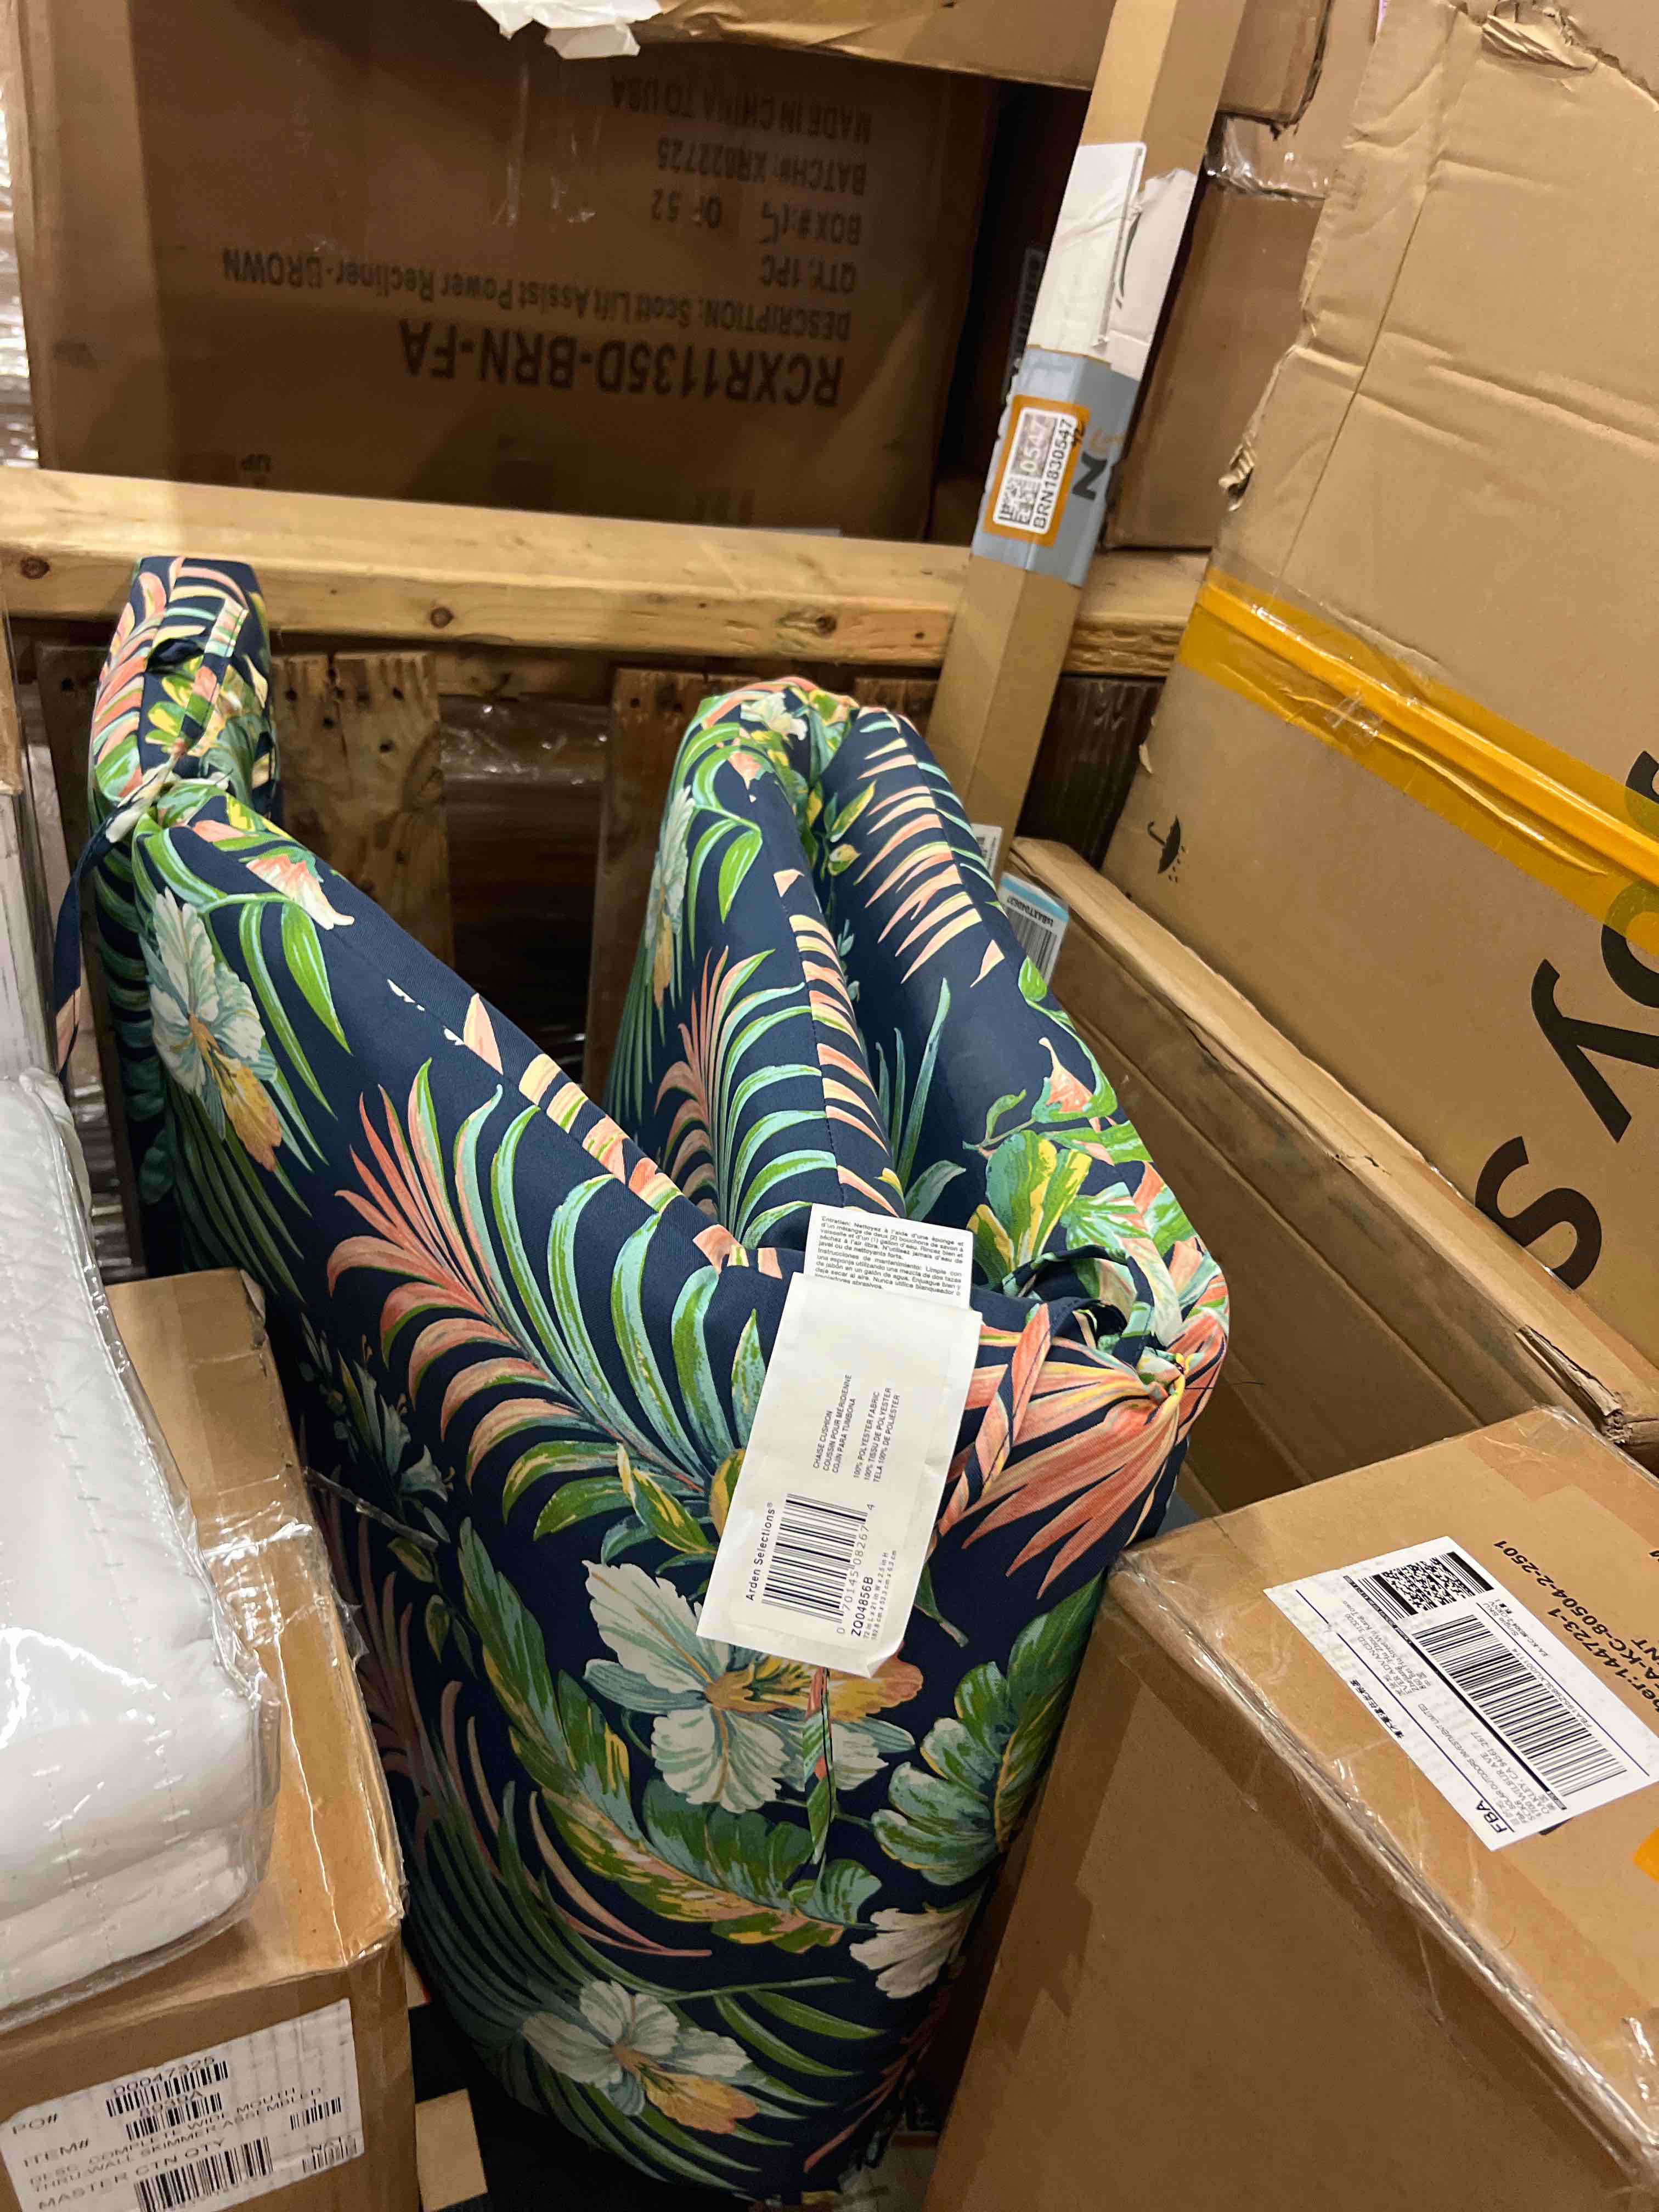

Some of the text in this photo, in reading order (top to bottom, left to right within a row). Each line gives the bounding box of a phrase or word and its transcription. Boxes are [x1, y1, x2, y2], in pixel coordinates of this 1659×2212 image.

[439, 274, 514, 310] Power
[399, 319, 844, 407] RCXR1135D-BRN-FA
[857, 1418, 873, 1460] POLYESTER
[867, 1391, 880, 1418] FABRIC
[875, 1387, 892, 1430] POLYESTER
[822, 1440, 836, 1471] COUSSIN
[830, 1419, 841, 1439] POUR
[837, 1433, 847, 1452] PARA
[867, 1442, 879, 1462] TISSU
[873, 1431, 881, 1441] DE
[873, 1465, 883, 1483] TELA
[882, 1435, 890, 1446] DE
[746, 1569, 761, 1601] Arden
[843, 1570, 859, 1611] 70145
[853, 1525, 870, 1565] 08267
[851, 1576, 874, 1637] ZQ04856B
[1482, 1602, 1499, 1616] SKU
[1493, 1541, 1659, 1689] A-KC-80504-2-2501
[1356, 1636, 1396, 1675] ADVANCED
[1392, 1675, 1413, 1694] EVER
[1435, 1724, 1471, 1758] INVESTMENT
[1480, 1752, 1499, 1769] AVE
[1504, 1767, 1519, 1780] CA
[1475, 1800, 1508, 1833] FBA
